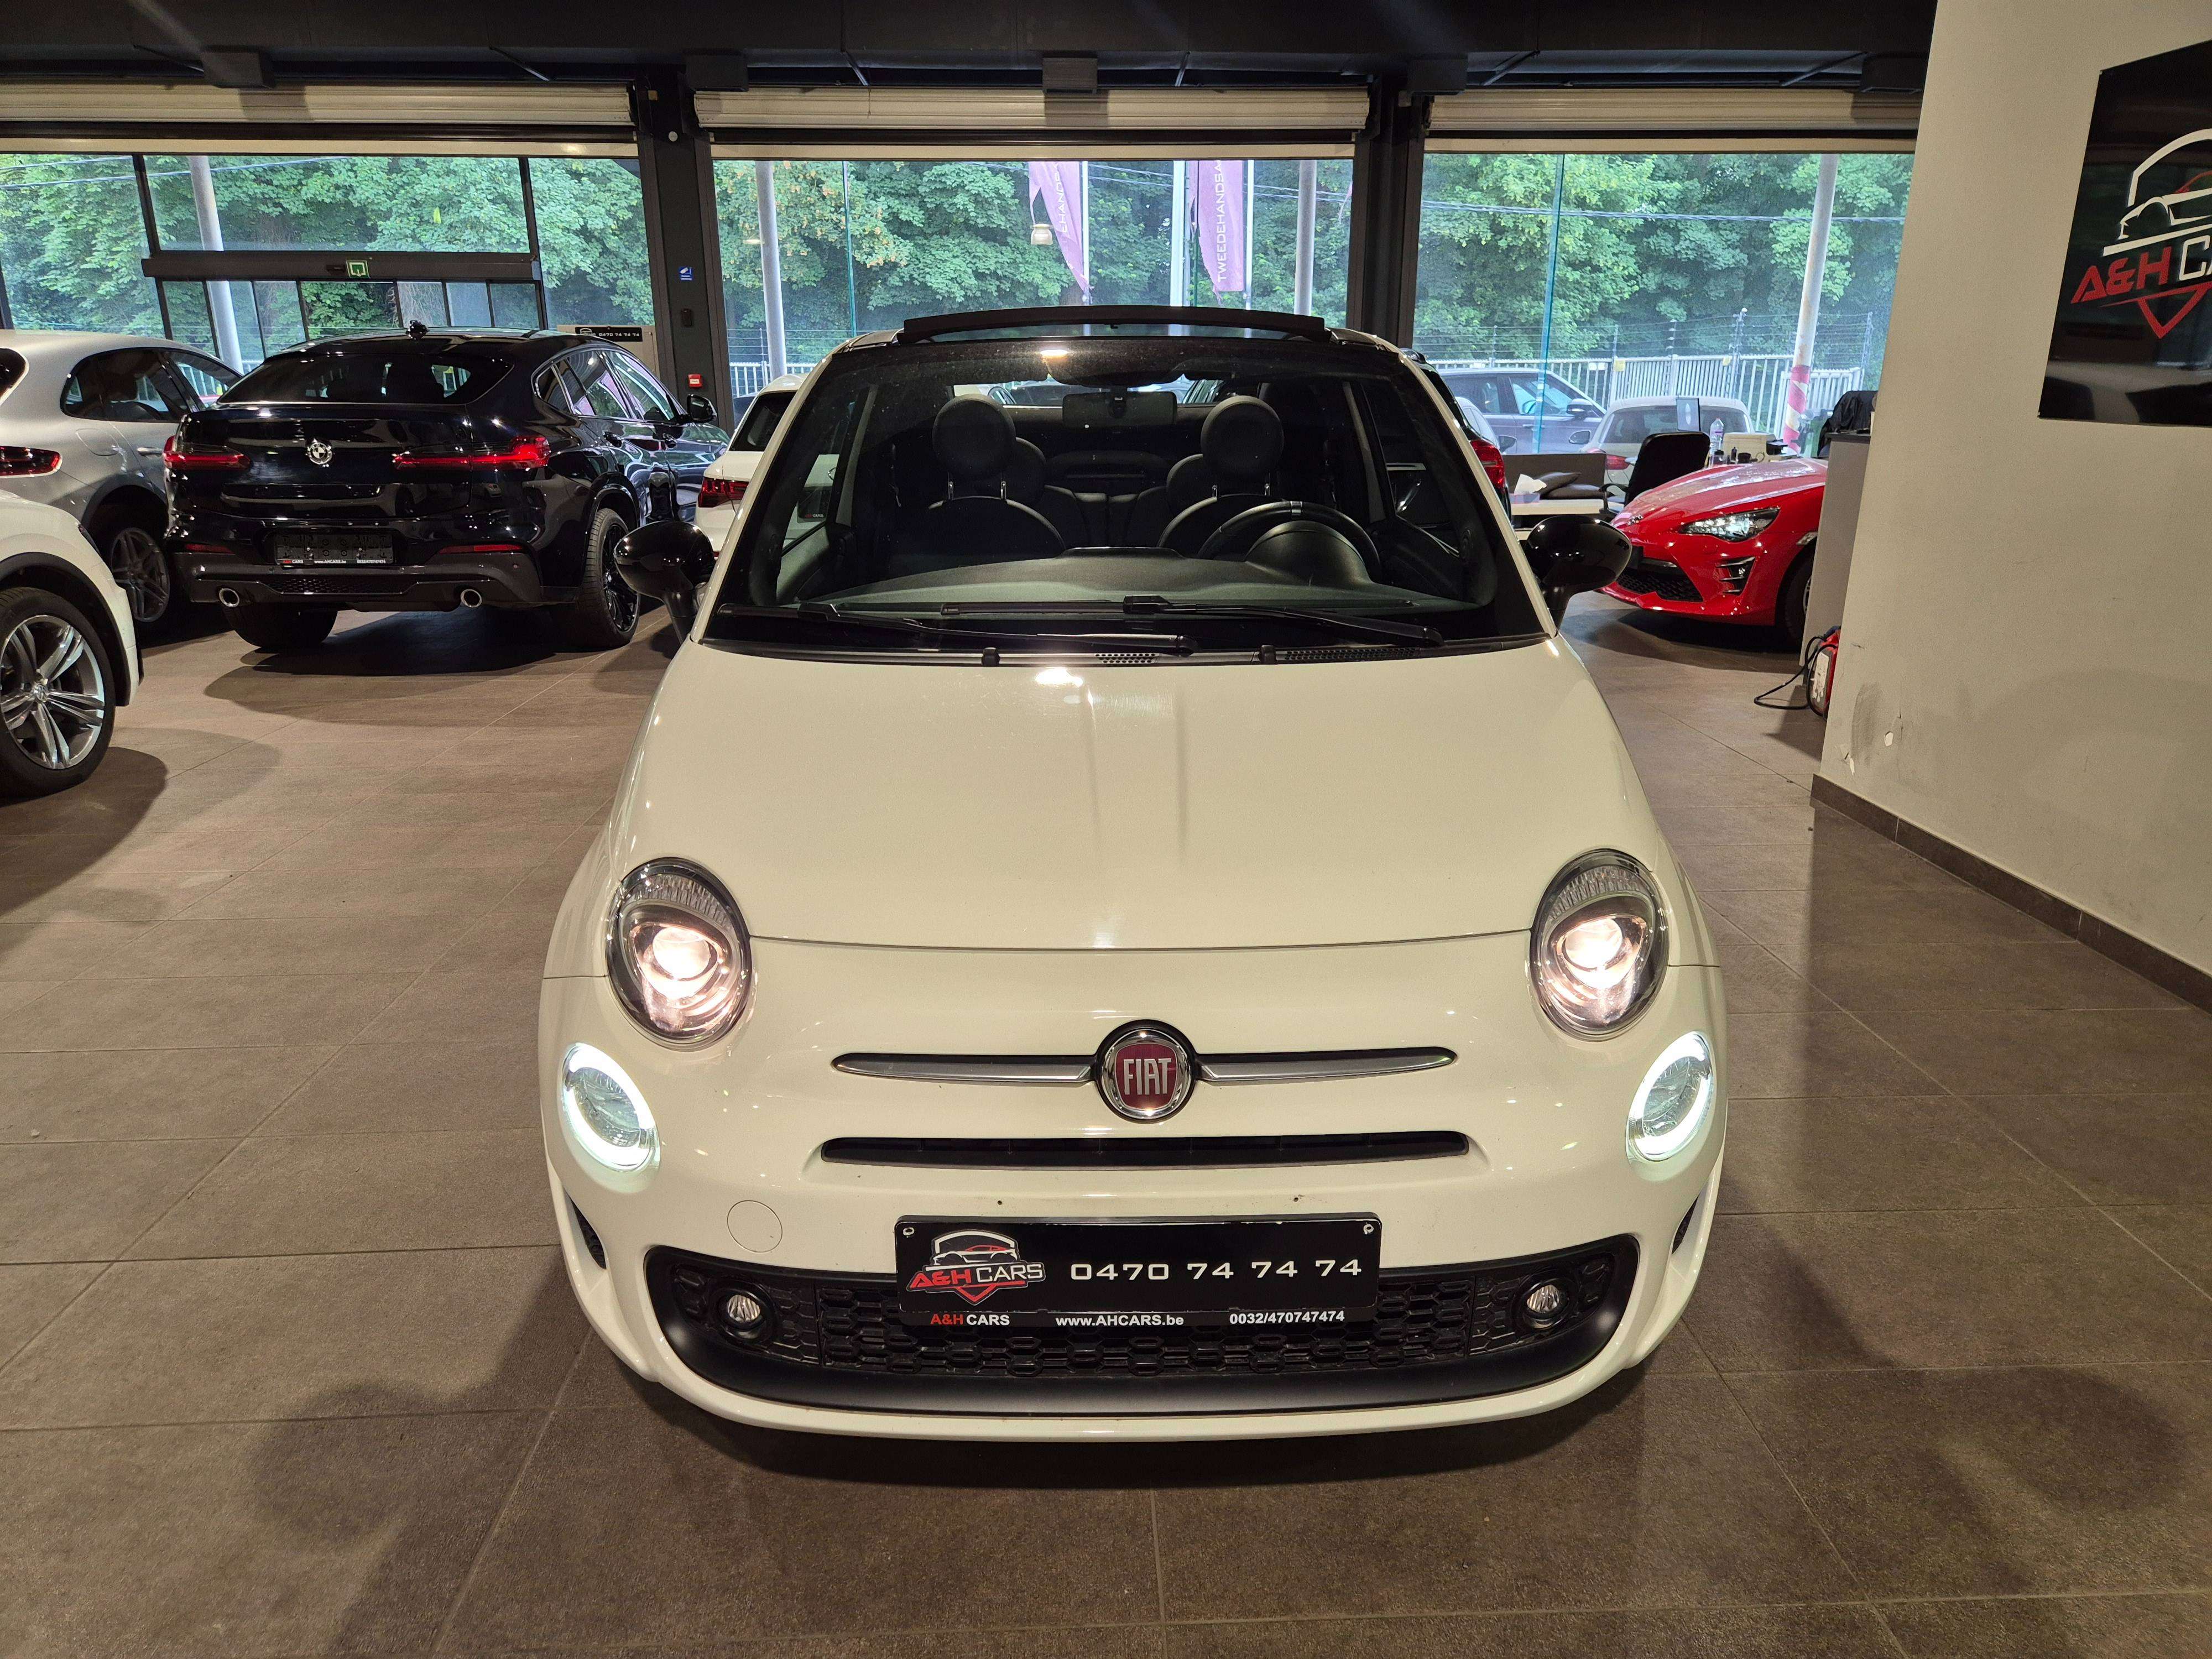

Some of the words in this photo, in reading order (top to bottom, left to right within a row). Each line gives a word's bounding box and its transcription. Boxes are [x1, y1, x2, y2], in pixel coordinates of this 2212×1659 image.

[1214, 160, 1227, 283] TWEEDEHANDSA
[2070, 246, 2171, 304] A&H
[2178, 234, 2212, 281] C
[1123, 1058, 1172, 1095] FIAT
[910, 1269, 972, 1288] A&H
[976, 1264, 1043, 1282] CARS
[1071, 1264, 1169, 1280] 0470
[1187, 1262, 1234, 1280] 74
[1251, 1260, 1298, 1279] 74
[1315, 1259, 1362, 1277] 74
[930, 1314, 964, 1326] A&H
[966, 1314, 1010, 1326] CARS
[1055, 1314, 1185, 1326] www.AHCARS.be
[1229, 1310, 1345, 1324] 0032/470747474
